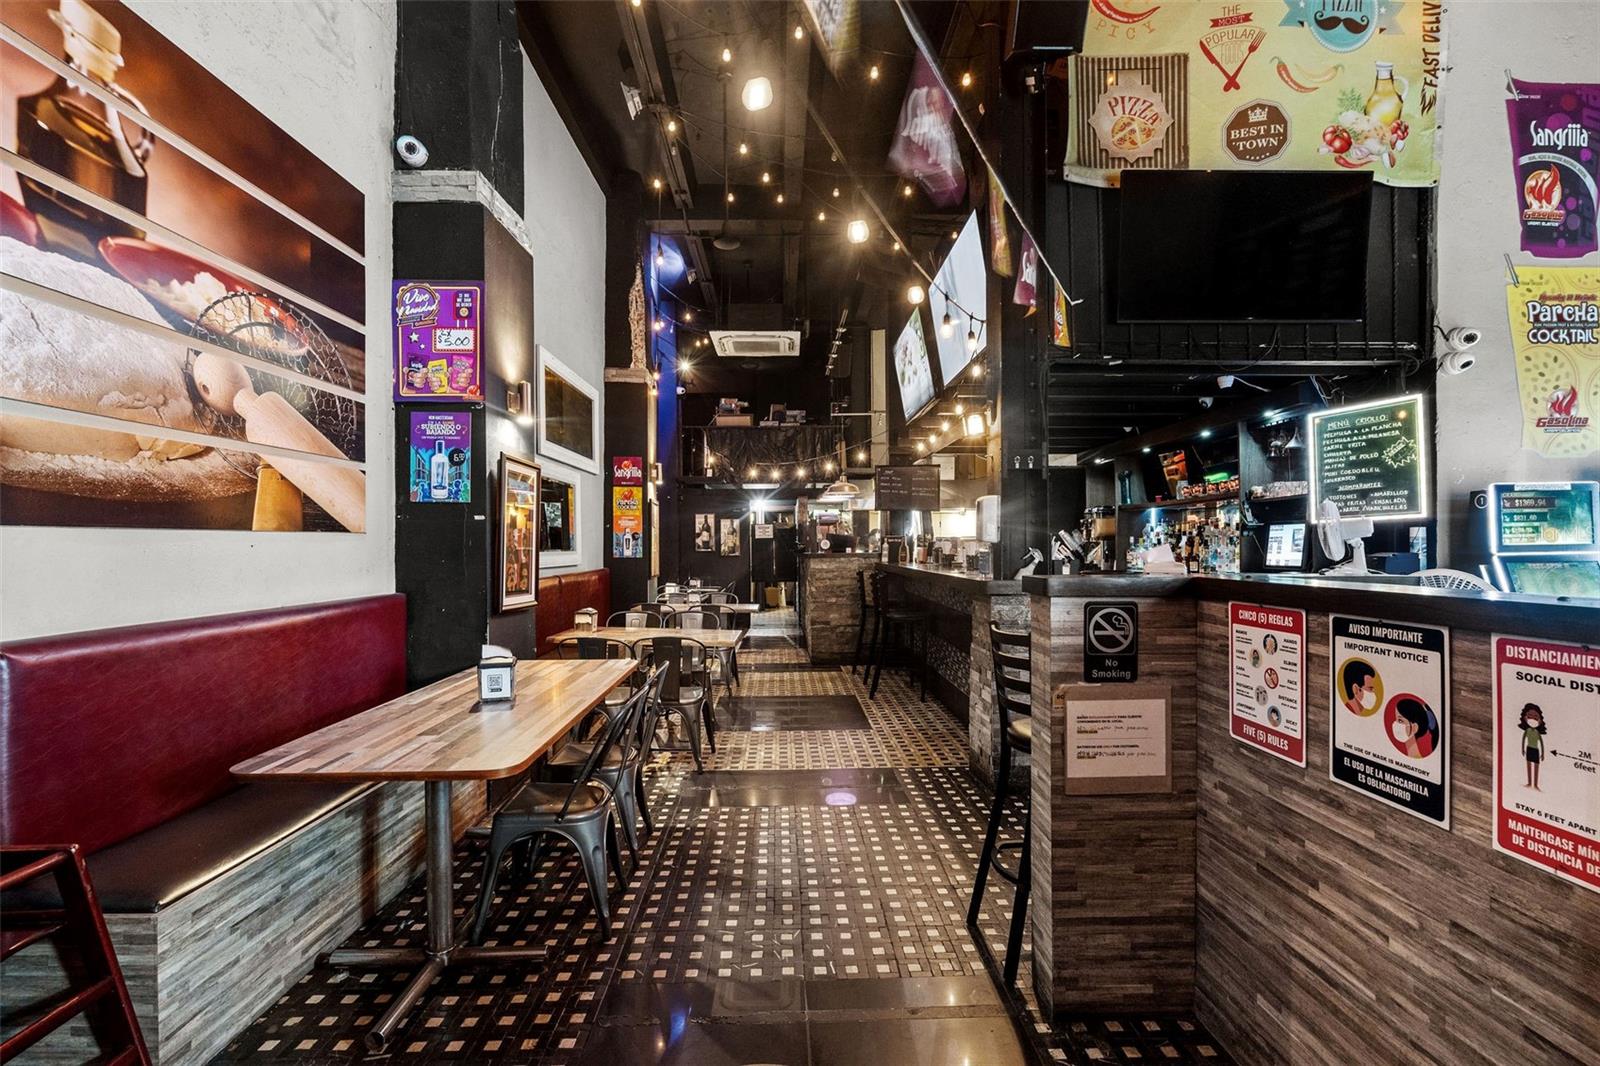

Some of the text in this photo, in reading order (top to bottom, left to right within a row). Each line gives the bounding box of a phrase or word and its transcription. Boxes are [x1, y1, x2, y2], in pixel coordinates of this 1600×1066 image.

[1222, 4, 1241, 16] THE
[1093, 20, 1156, 40] PICY
[1218, 15, 1245, 26] MOST
[1204, 28, 1256, 48] POPULAR
[1422, 47, 1440, 88] FAST
[1107, 95, 1163, 126] PIZZA
[1230, 123, 1285, 140] BEST IN
[1530, 120, 1589, 150] Sangriiia
[1236, 136, 1279, 151] TOWN
[1528, 329, 1598, 344] COCKTAIL
[1536, 415, 1590, 428] Gasolina
[1360, 452, 1379, 460] POLLO
[1239, 609, 1294, 627] CINCO (5) REGLAS
[1348, 623, 1424, 644] AVISO IMPORTANTE
[1344, 641, 1429, 664] IMPORTANT NOTICE
[1106, 659, 1118, 667] No
[1092, 669, 1131, 680] Smoking
[1516, 671, 1566, 688] SOCIAL
[1243, 724, 1289, 750] FIVE (5) RULES
[1343, 742, 1353, 750] THE
[1372, 753, 1387, 762] MASK
[1395, 760, 1430, 777] MANDATORY
[1578, 750, 1592, 760] 2M
[1344, 756, 1429, 797] EL USO DE LA MASCARILLA
[1574, 762, 1596, 774] 6feet
[1358, 773, 1411, 801] ES OBLIGATORIO
[1515, 802, 1535, 814] STAY
[1544, 812, 1565, 825] FEET
[1568, 821, 1597, 836] APART
[1508, 818, 1575, 852] MANTENGASE
[1512, 834, 1525, 848] DE
[1527, 839, 1584, 871] DISTANCIA
